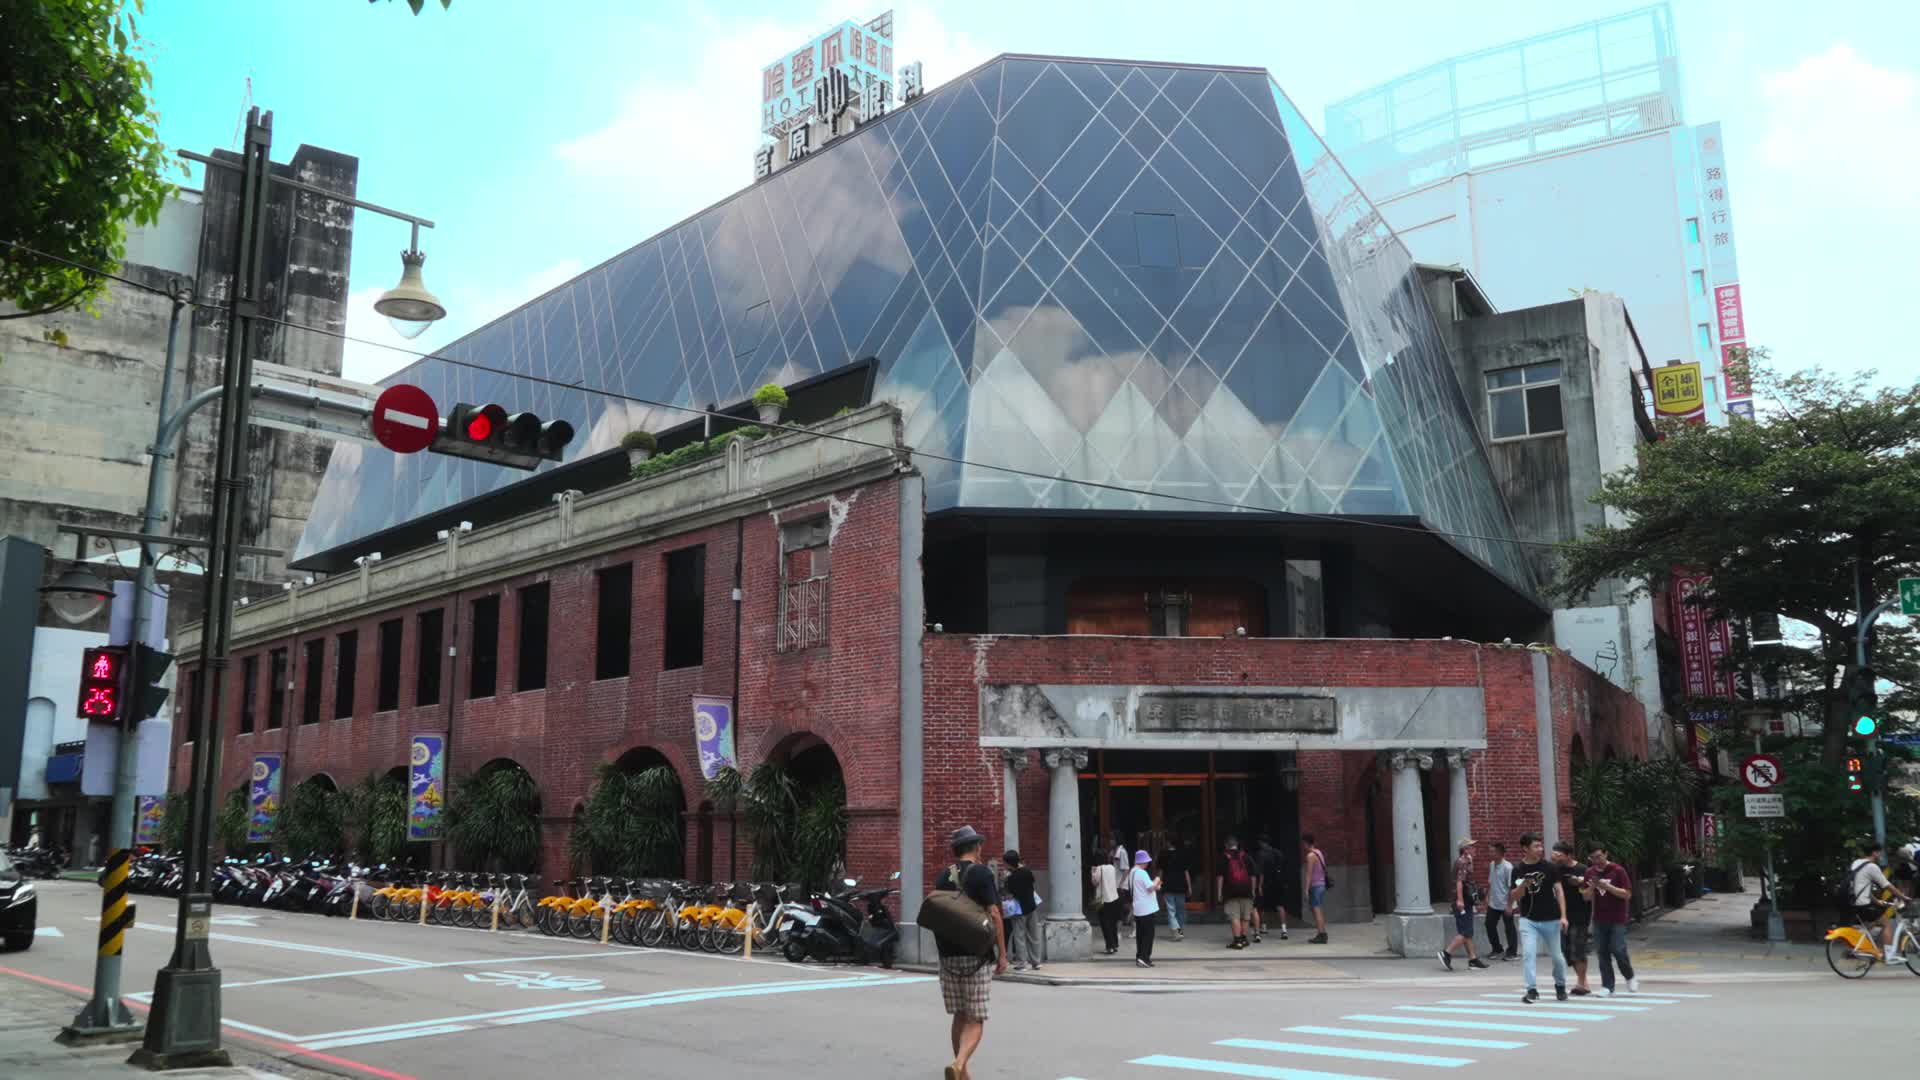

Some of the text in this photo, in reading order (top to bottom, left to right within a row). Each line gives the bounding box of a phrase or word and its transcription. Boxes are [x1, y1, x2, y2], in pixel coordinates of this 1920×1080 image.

[1706, 167, 1729, 247] 路得行旅
[83, 688, 112, 714] 25
